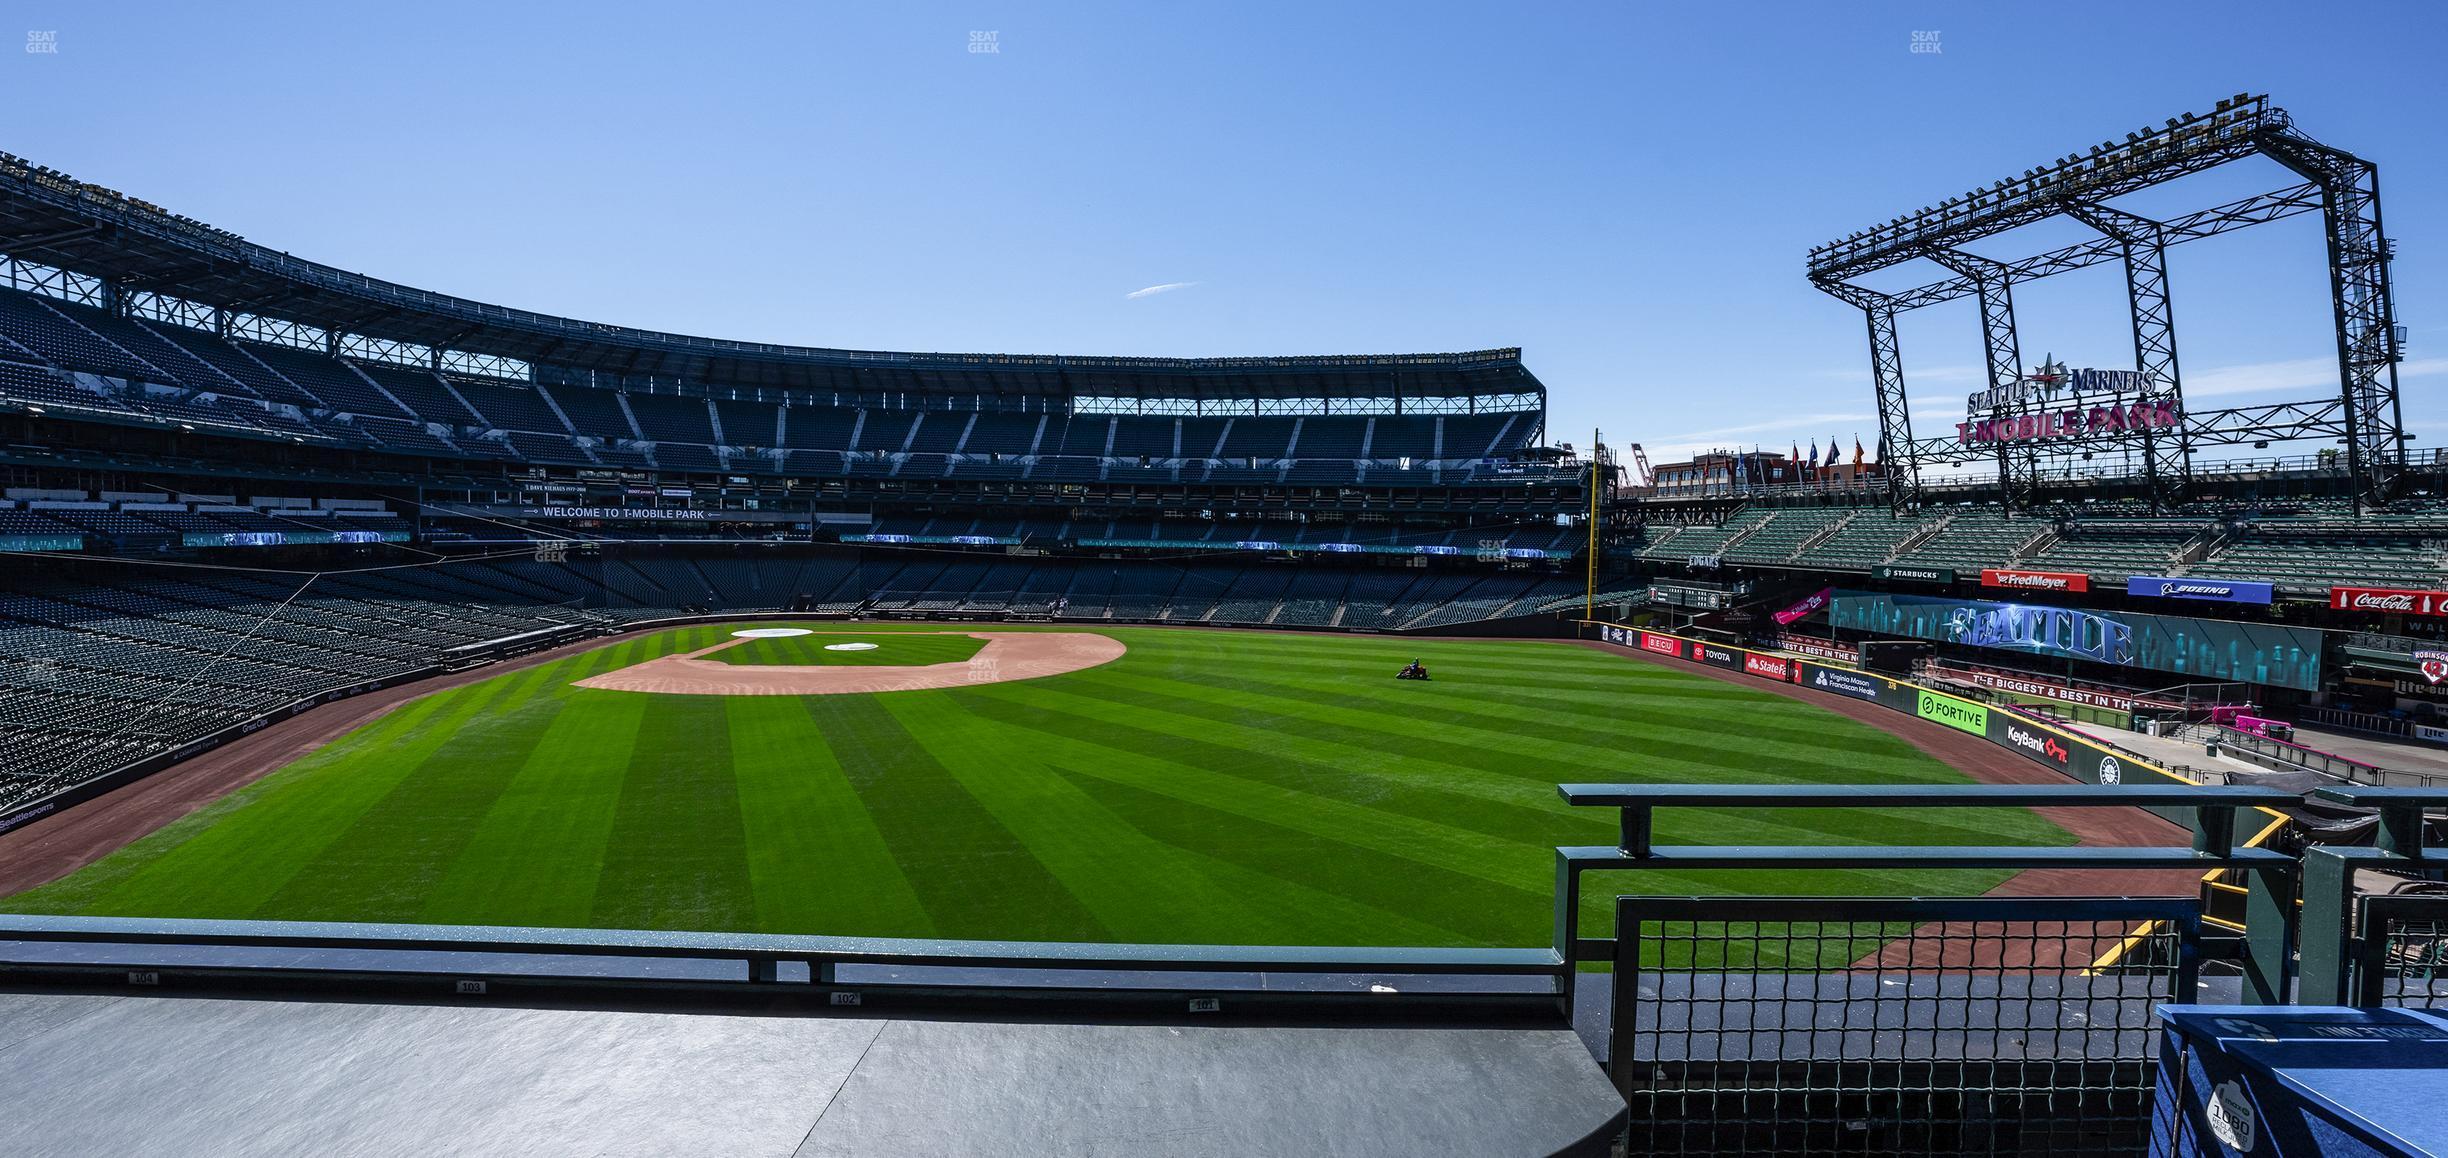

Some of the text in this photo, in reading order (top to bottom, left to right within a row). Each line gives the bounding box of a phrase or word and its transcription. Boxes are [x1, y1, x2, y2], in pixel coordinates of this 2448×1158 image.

[1967, 368, 2155, 414] SEATTLE MARINERS
[1955, 399, 2182, 445] T-MOBILE PARK
[543, 507, 704, 519] WELCOME TO T-MOBILE PARK
[1893, 570, 1937, 579] STARBUCKS
[2177, 585, 2230, 594] BOEING
[2354, 593, 2414, 610] Coca-Cola
[1650, 638, 1673, 650] BECU
[1705, 650, 1731, 662] TOYOTA
[1805, 647, 1823, 656] BEST
[2424, 660, 2444, 678] 42
[1829, 673, 1870, 686] Virginia Mason
[1829, 680, 1876, 696] Franciscan Health
[1973, 675, 1993, 686] THE
[1997, 678, 2045, 694] BIGGEST
[2048, 688, 2056, 697] &
[2060, 690, 2091, 703] BEST
[2095, 695, 2109, 705] IN
[1936, 703, 1982, 727] FORTIVE
[2007, 725, 2045, 754] KeyBank
[463, 982, 480, 991] 103
[838, 994, 856, 1004] 102
[2213, 1104, 2249, 1136] 1080
